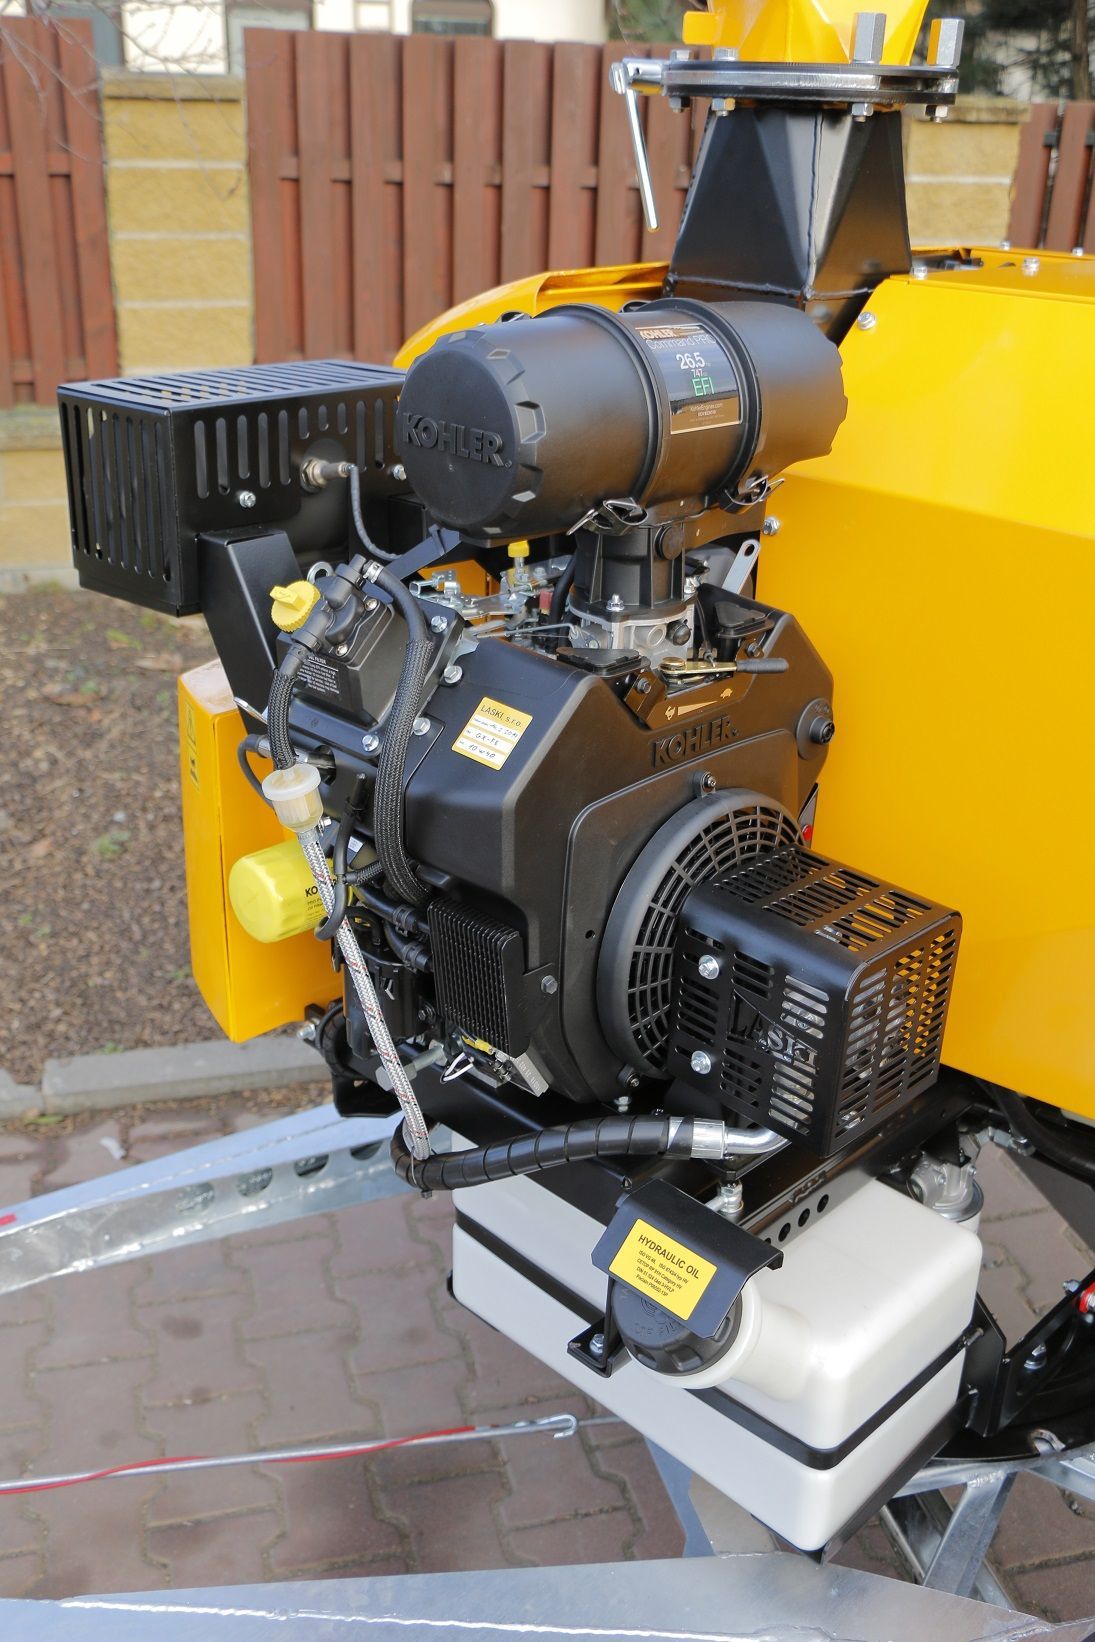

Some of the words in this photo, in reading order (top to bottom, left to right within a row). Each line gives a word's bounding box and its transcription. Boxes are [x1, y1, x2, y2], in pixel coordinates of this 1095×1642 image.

[639, 328, 677, 340] KOHLER
[645, 335, 694, 350] Command
[675, 352, 706, 370] 26.5
[692, 377, 715, 397] EFI
[402, 412, 505, 467] KOHLER
[649, 715, 732, 768] KOHLER
[638, 1234, 686, 1270] HYDRAULIC
[686, 1264, 700, 1280] OIL
